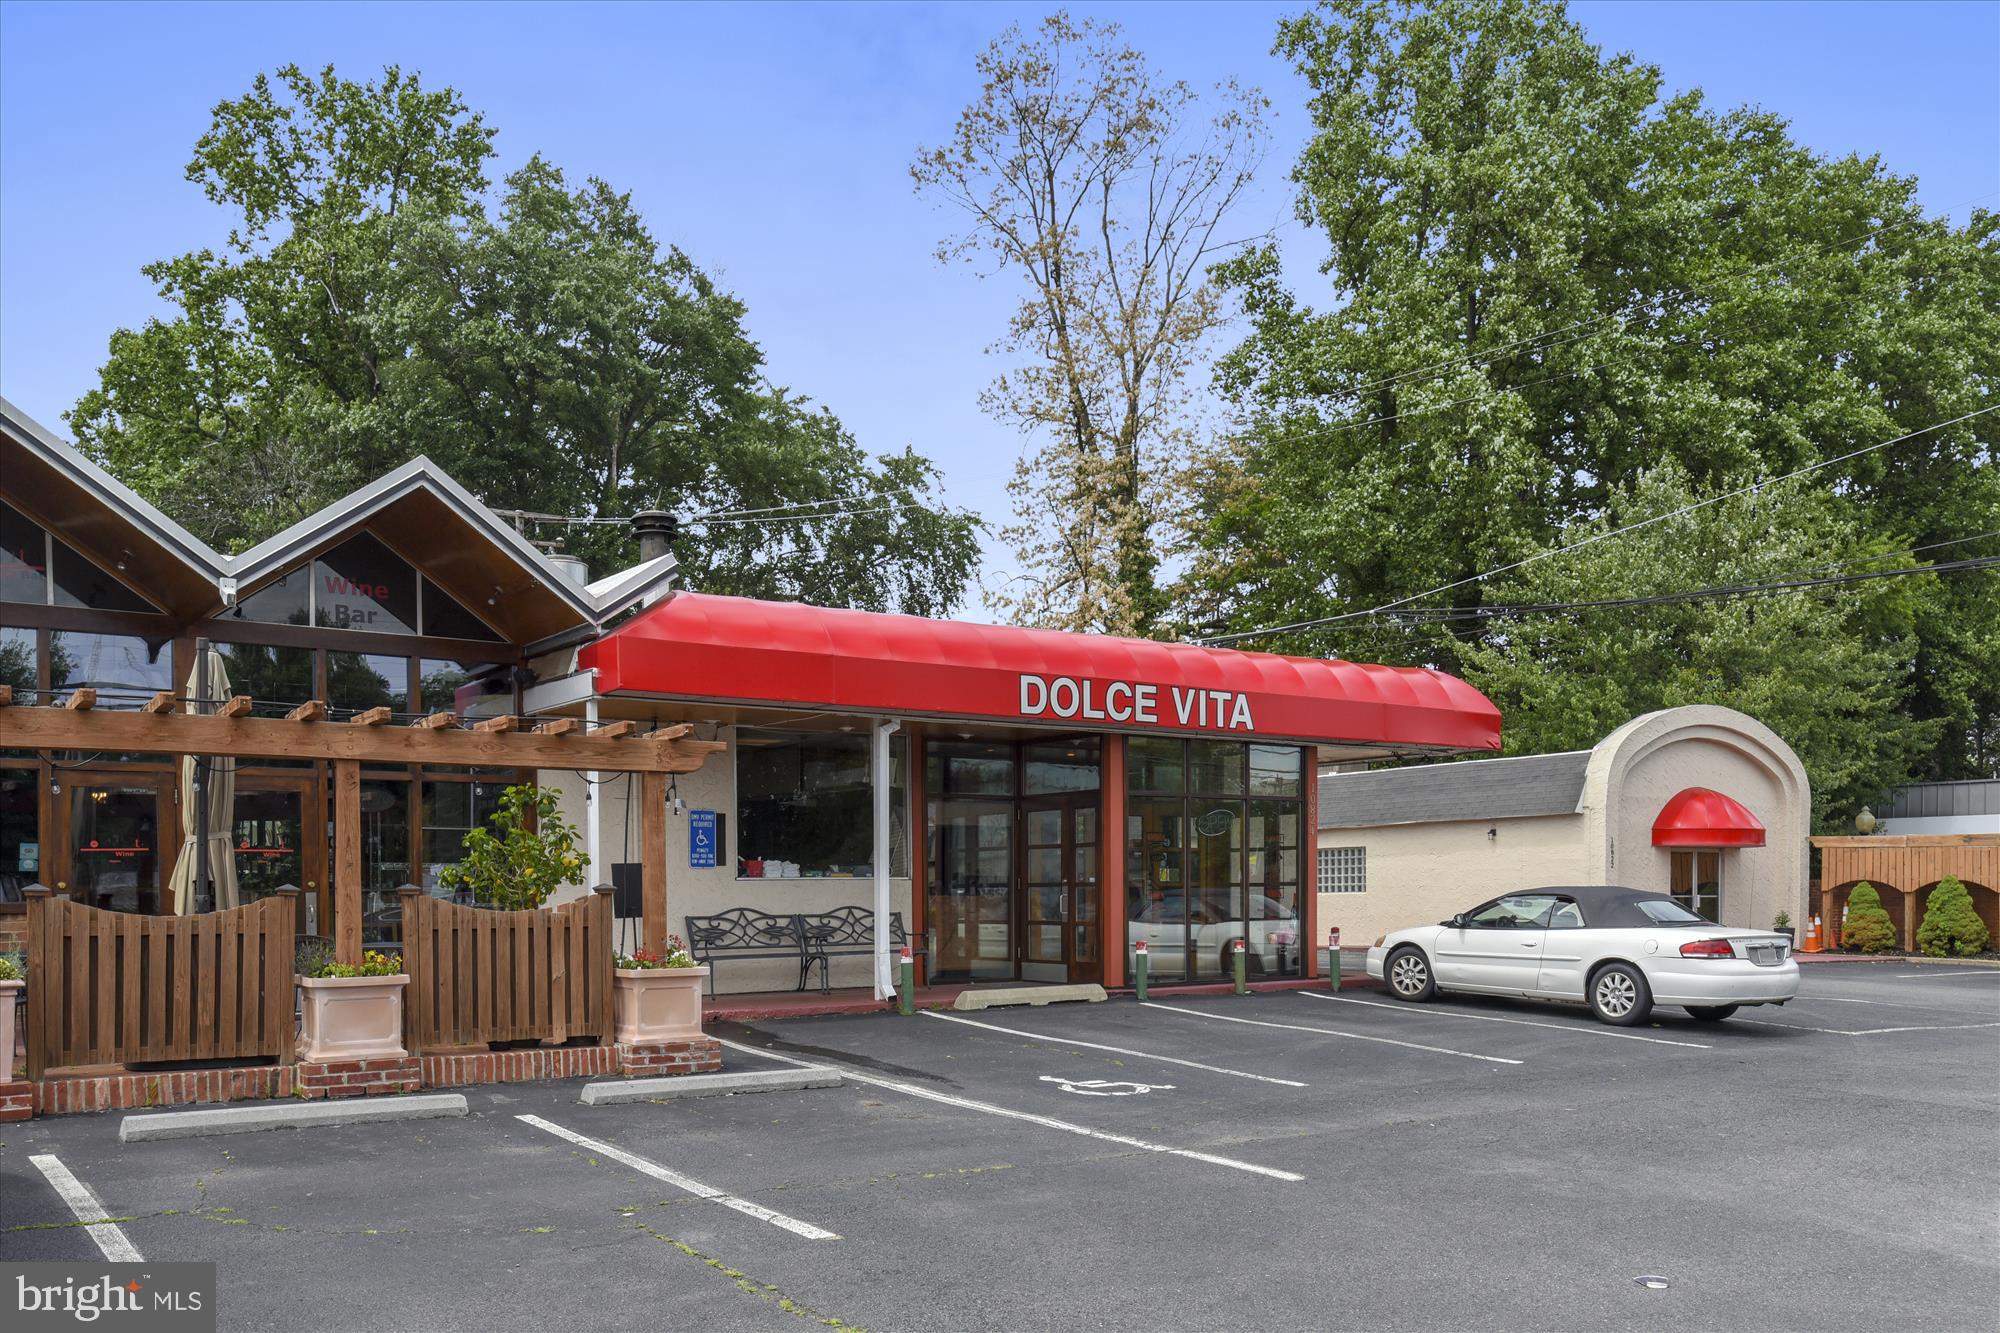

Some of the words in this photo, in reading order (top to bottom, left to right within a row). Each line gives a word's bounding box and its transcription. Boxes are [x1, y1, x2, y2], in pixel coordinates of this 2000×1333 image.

[323, 576, 390, 600] Wine
[335, 604, 378, 625] Bar
[1019, 674, 1158, 723] DOLCE
[1171, 686, 1255, 730] VITA
